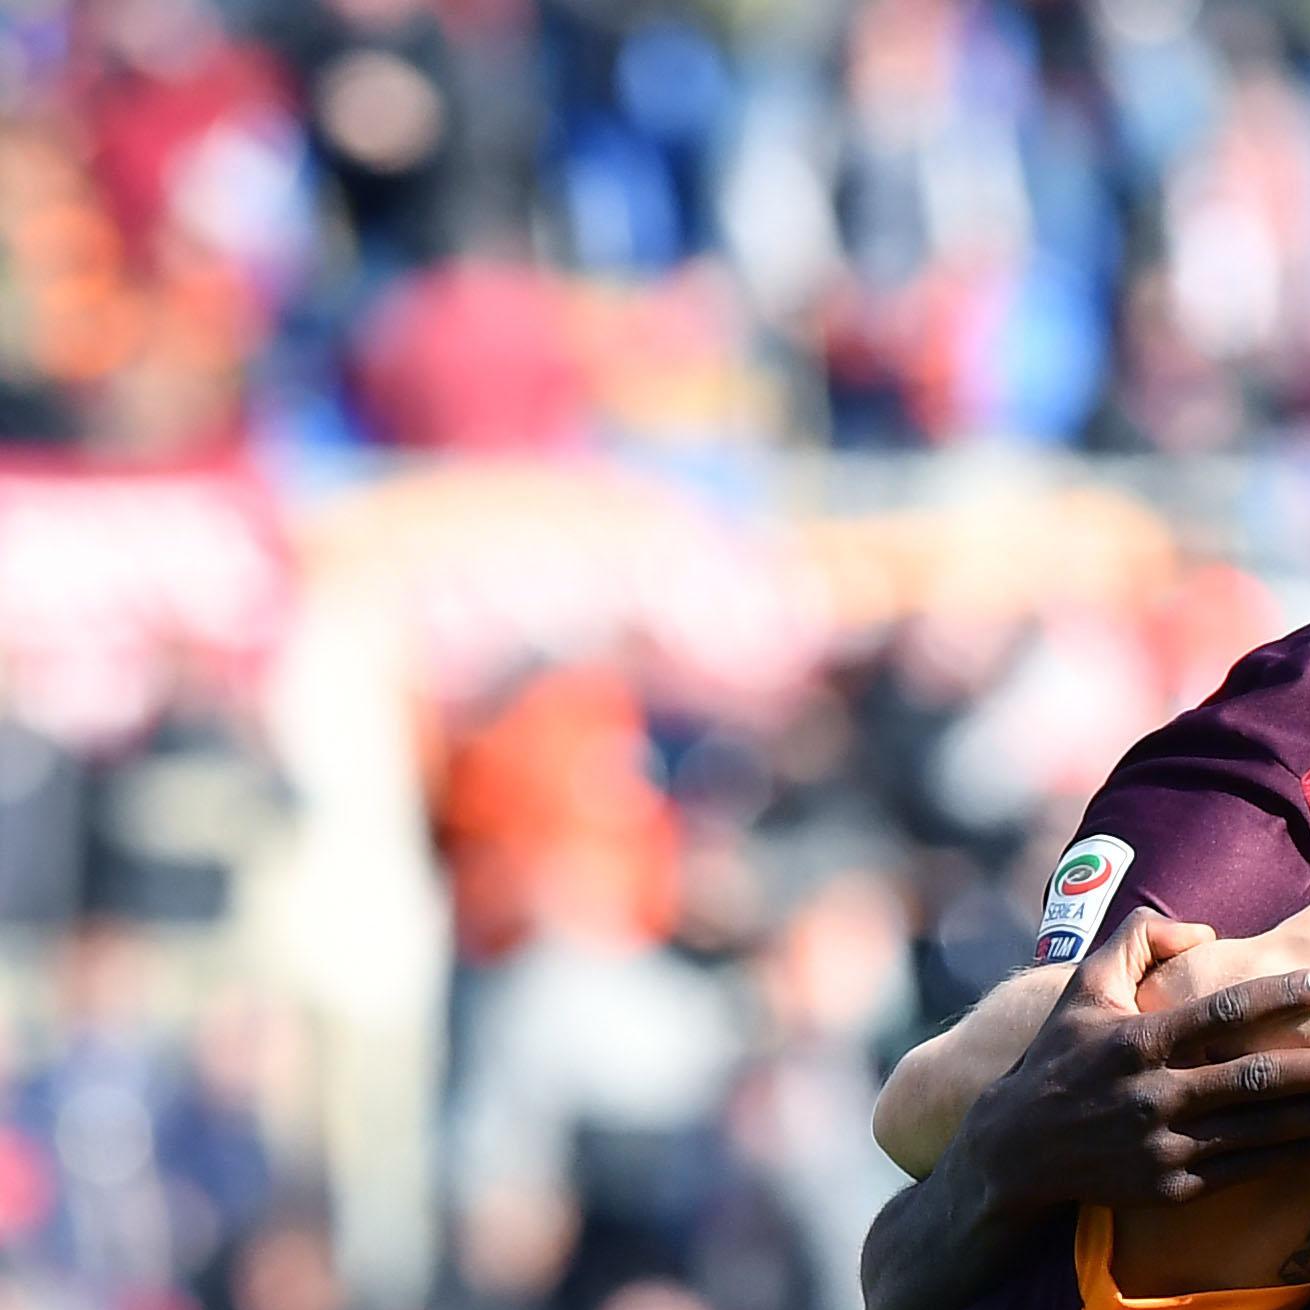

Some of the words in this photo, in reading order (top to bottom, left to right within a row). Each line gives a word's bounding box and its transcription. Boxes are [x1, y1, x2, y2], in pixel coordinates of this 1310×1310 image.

[1044, 902, 1074, 922] SERIE
[1074, 903, 1086, 920] A
[1047, 936, 1075, 958] TIM
